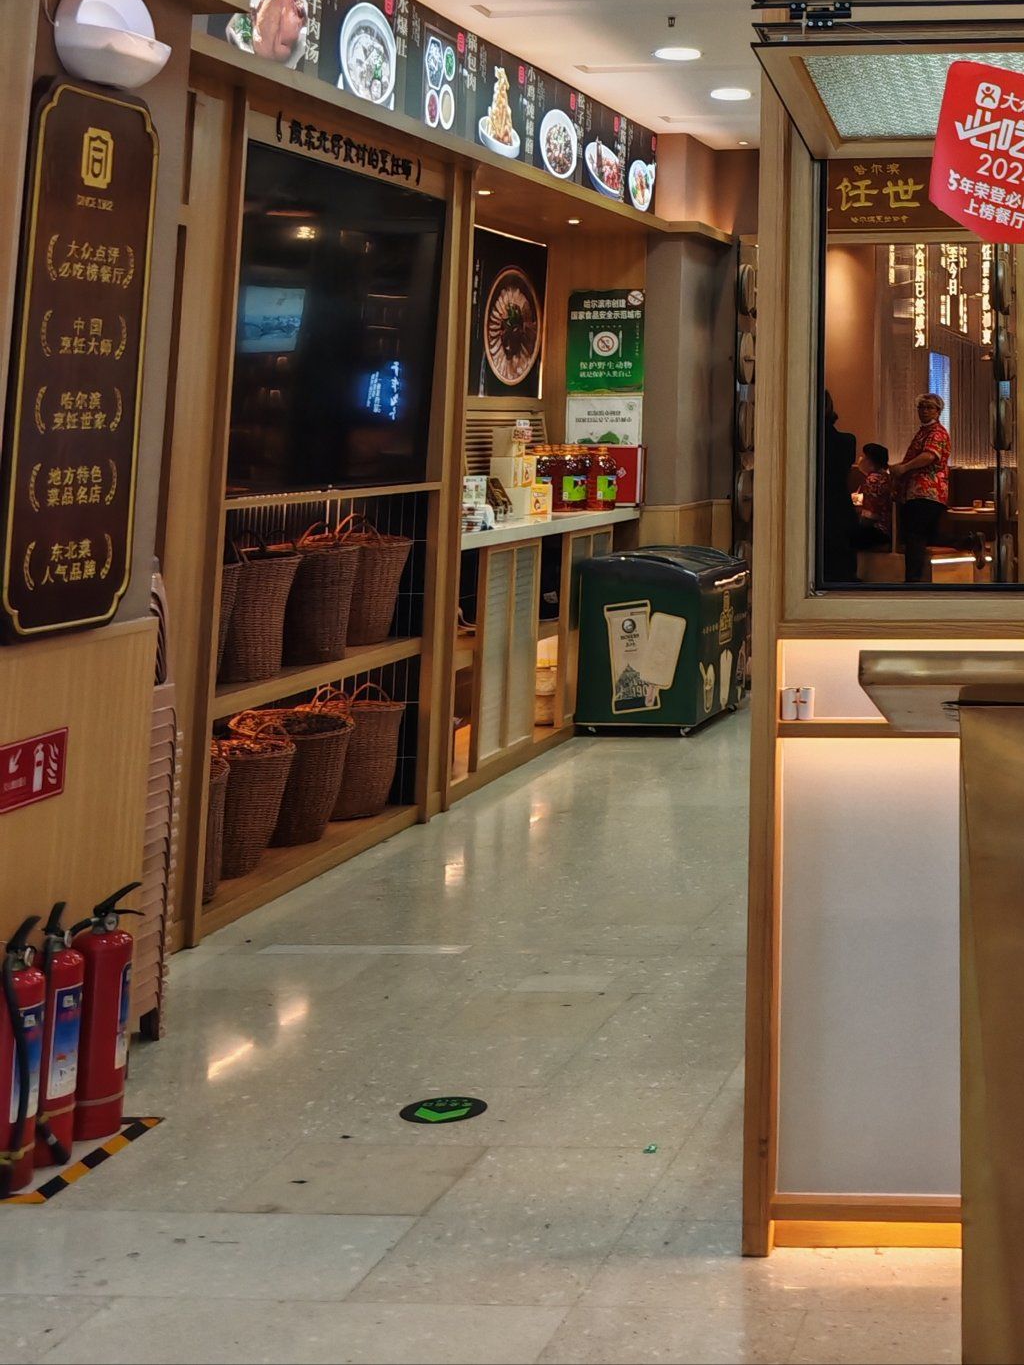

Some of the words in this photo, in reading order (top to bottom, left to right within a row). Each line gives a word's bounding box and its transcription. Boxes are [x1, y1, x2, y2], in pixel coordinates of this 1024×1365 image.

[827, 177, 925, 211] 饪世
[67, 240, 120, 264] 大众点评
[58, 261, 125, 284] 必吃榜餐厅
[73, 317, 103, 336] 中国
[59, 336, 113, 356] 烹饪大师
[580, 361, 633, 371] 保护野生动物
[61, 391, 102, 410] 哈尔滨
[52, 411, 107, 431] 烹饪世家
[47, 465, 103, 486] 地方特色
[46, 484, 103, 507] 菜品名店
[50, 538, 92, 562] 东北菜
[41, 559, 97, 585] 人气品牌
